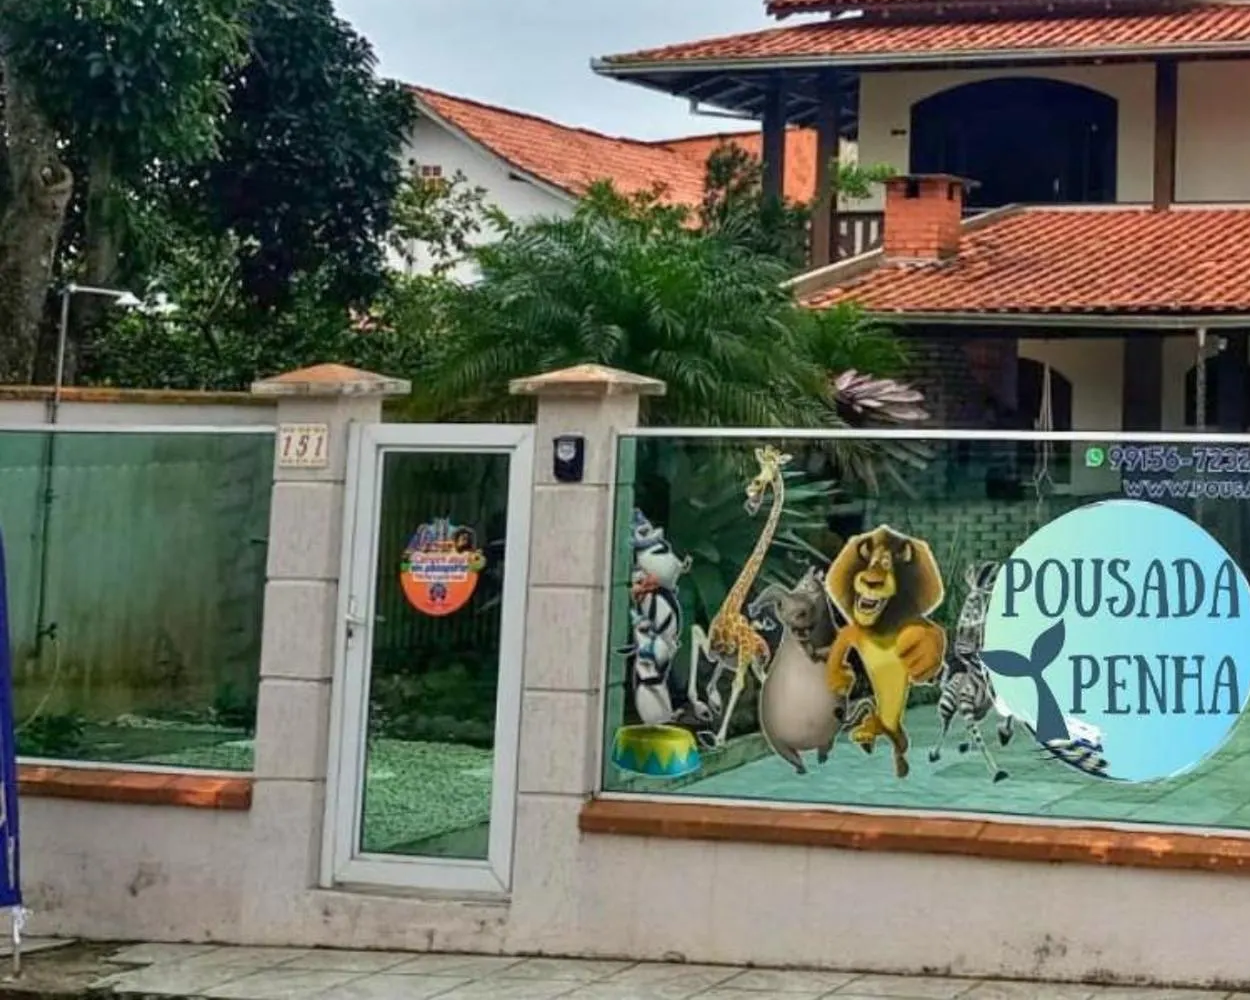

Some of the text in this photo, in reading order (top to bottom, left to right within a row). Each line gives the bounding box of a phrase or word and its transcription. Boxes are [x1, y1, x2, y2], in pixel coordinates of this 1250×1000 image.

[283, 435, 323, 457] 151
[1001, 558, 1240, 618] POUSADA
[1068, 655, 1240, 715] PENHA
